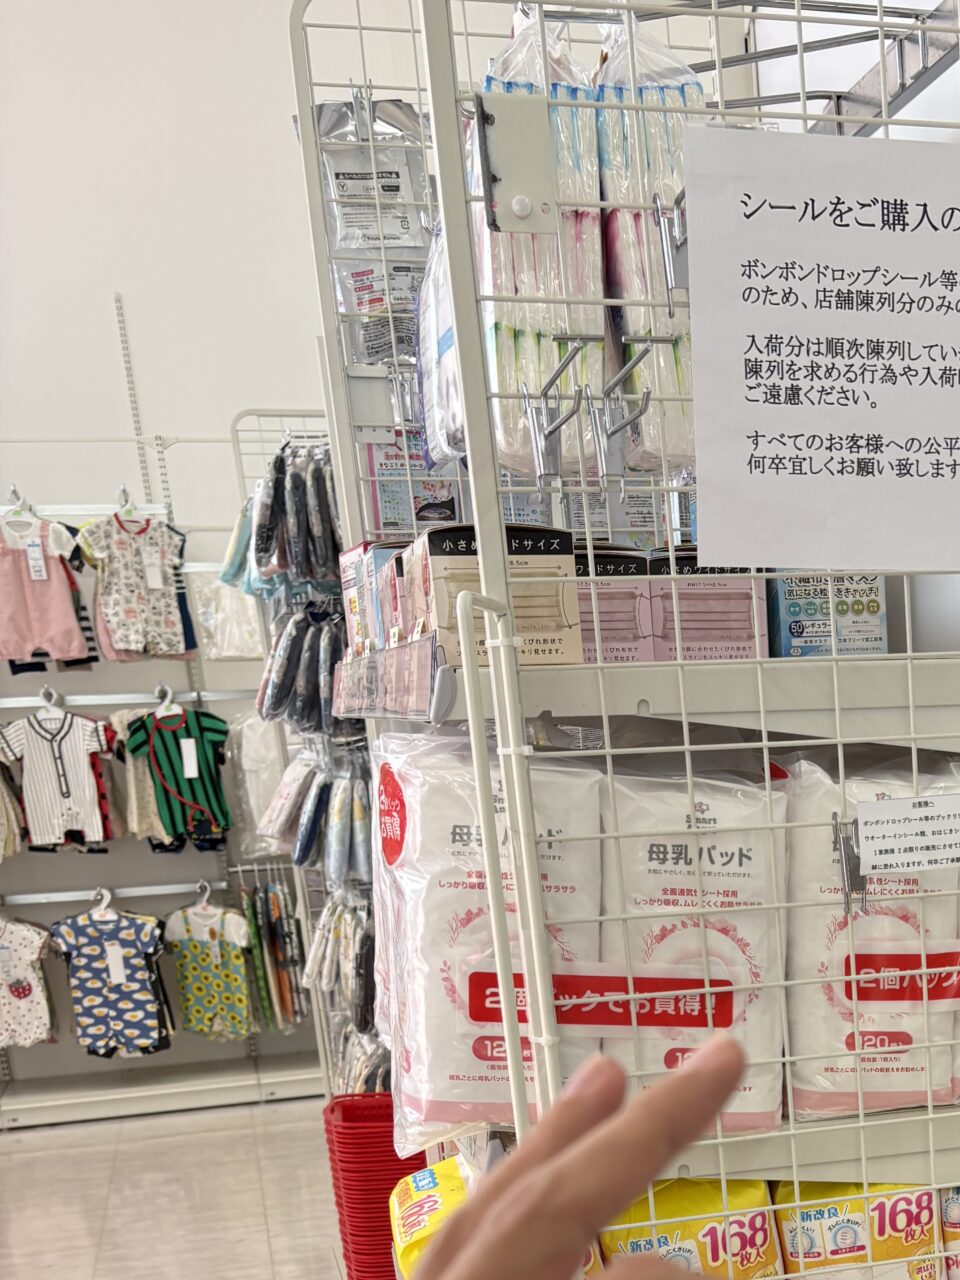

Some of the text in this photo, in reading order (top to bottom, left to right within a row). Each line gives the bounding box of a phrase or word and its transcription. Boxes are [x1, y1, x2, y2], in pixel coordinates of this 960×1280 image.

[744, 383, 878, 410] ご遠慮ください。
[787, 587, 879, 597] 気になる粒をキャッチ!
[648, 842, 753, 867] 母乳パッド
[800, 1207, 839, 1221] 新改良
[871, 1193, 934, 1237] 168
[701, 1213, 768, 1263] 168
